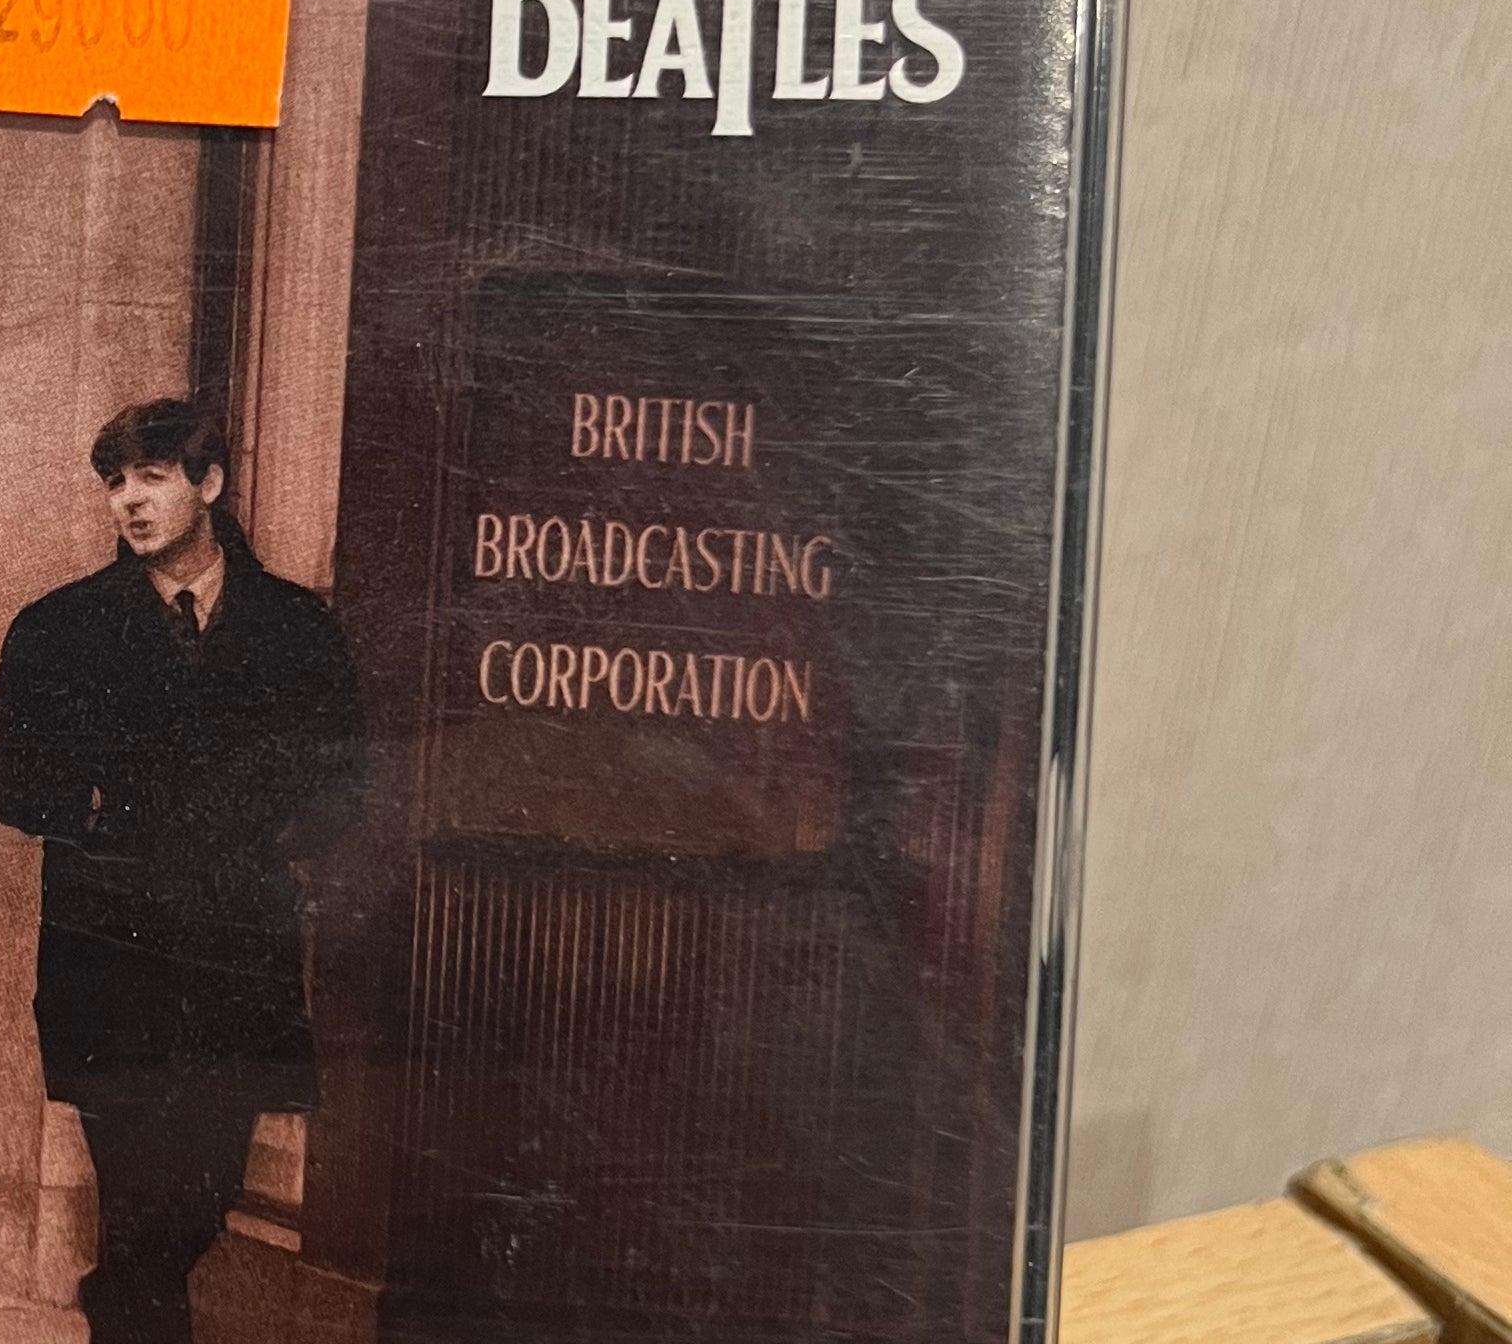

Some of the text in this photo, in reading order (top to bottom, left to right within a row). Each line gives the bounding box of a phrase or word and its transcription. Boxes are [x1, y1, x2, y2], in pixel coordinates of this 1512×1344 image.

[570, 392, 754, 468] BRITISH
[474, 513, 834, 602] BROADCASTING
[478, 639, 814, 725] CORPORATION
